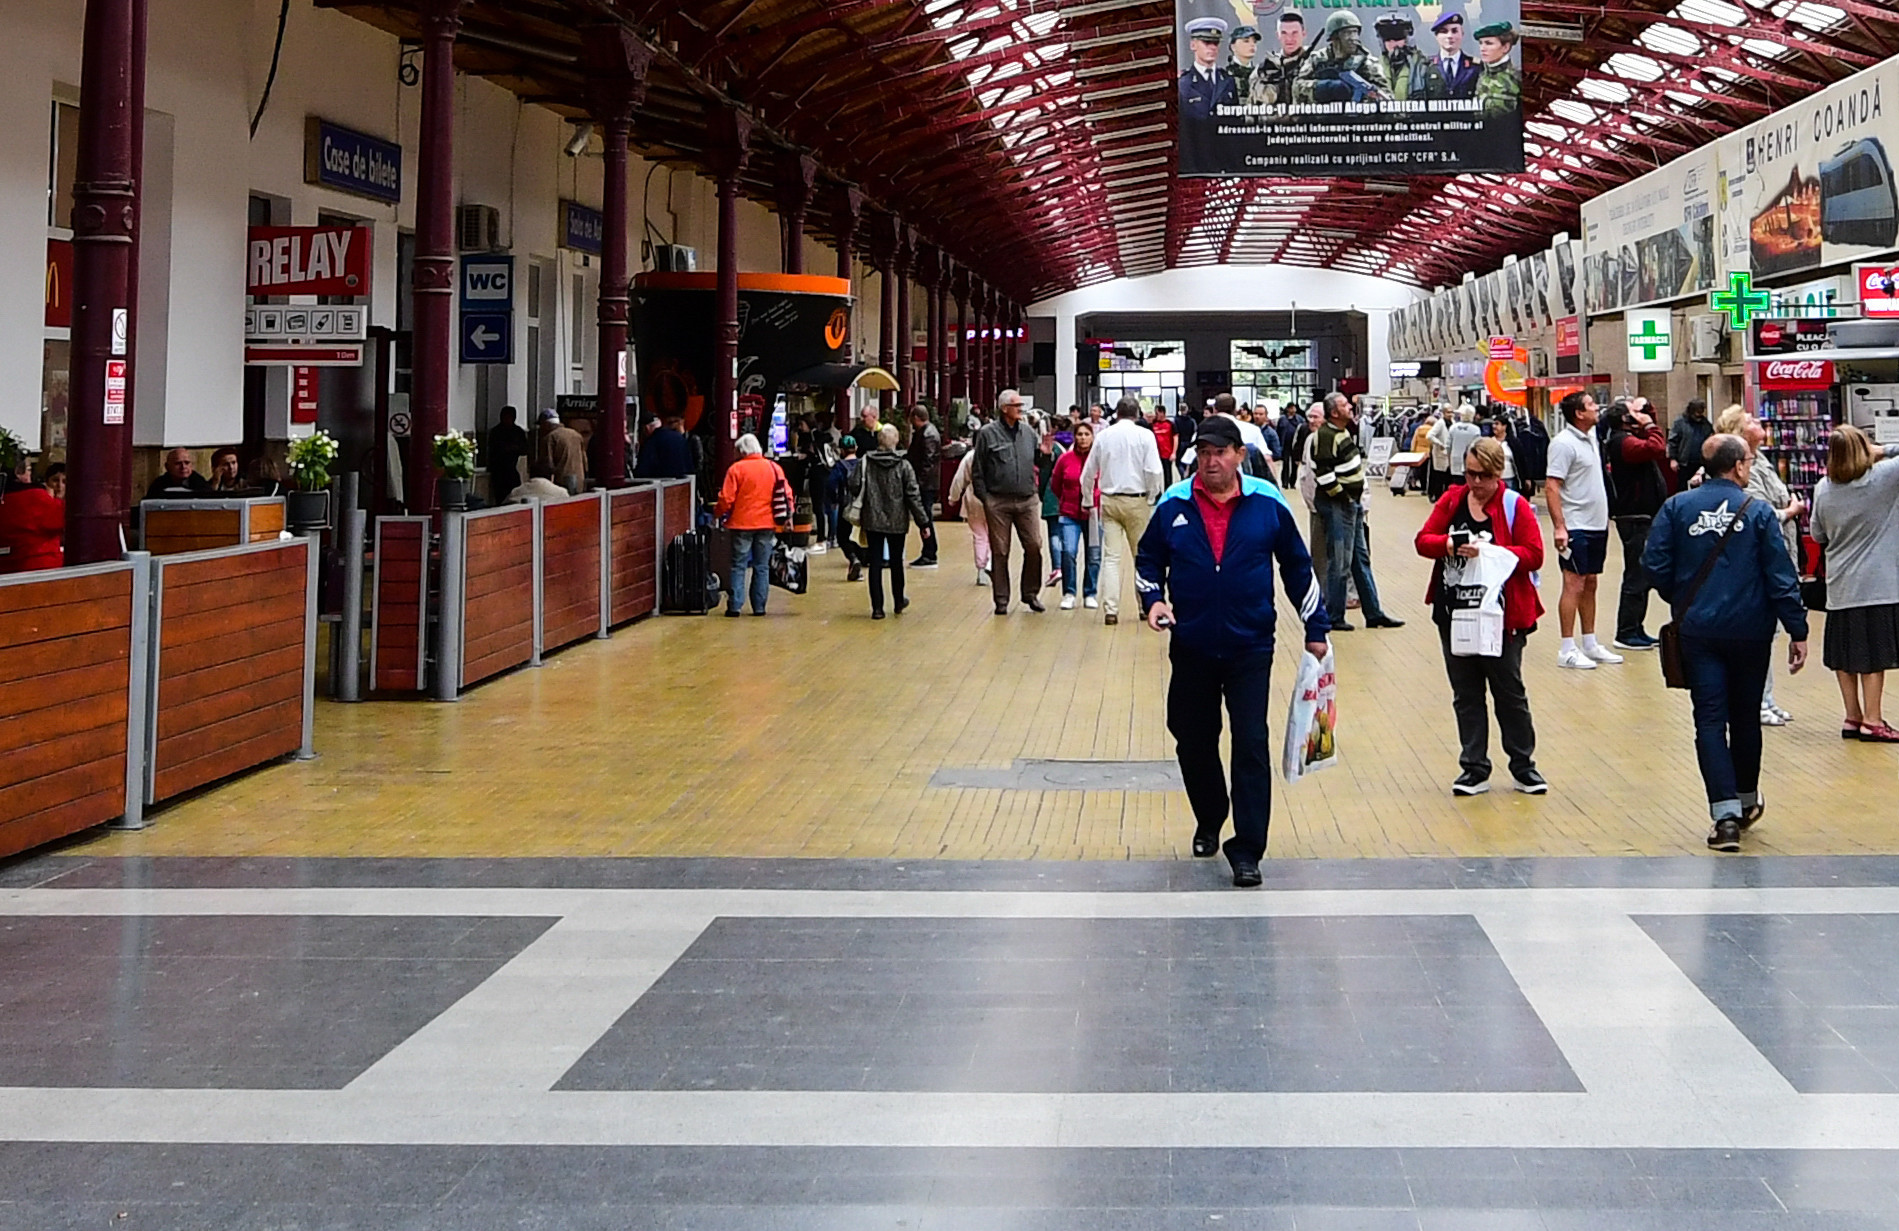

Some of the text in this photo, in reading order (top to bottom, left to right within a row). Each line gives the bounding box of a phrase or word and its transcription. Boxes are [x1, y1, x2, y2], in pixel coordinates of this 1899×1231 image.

[1380, 100, 1427, 113] CARIERA
[1757, 120, 1798, 167] HENRI
[1813, 78, 1883, 142] COANDĂ
[323, 136, 398, 190] Case de bilete
[1385, 152, 1409, 163] CNCF
[1441, 151, 1460, 163] S.A.
[249, 230, 352, 287] RELAY
[468, 272, 507, 292] WC
[1630, 334, 1670, 345] FARMACIE
[1766, 360, 1825, 380] Coca-Cola
